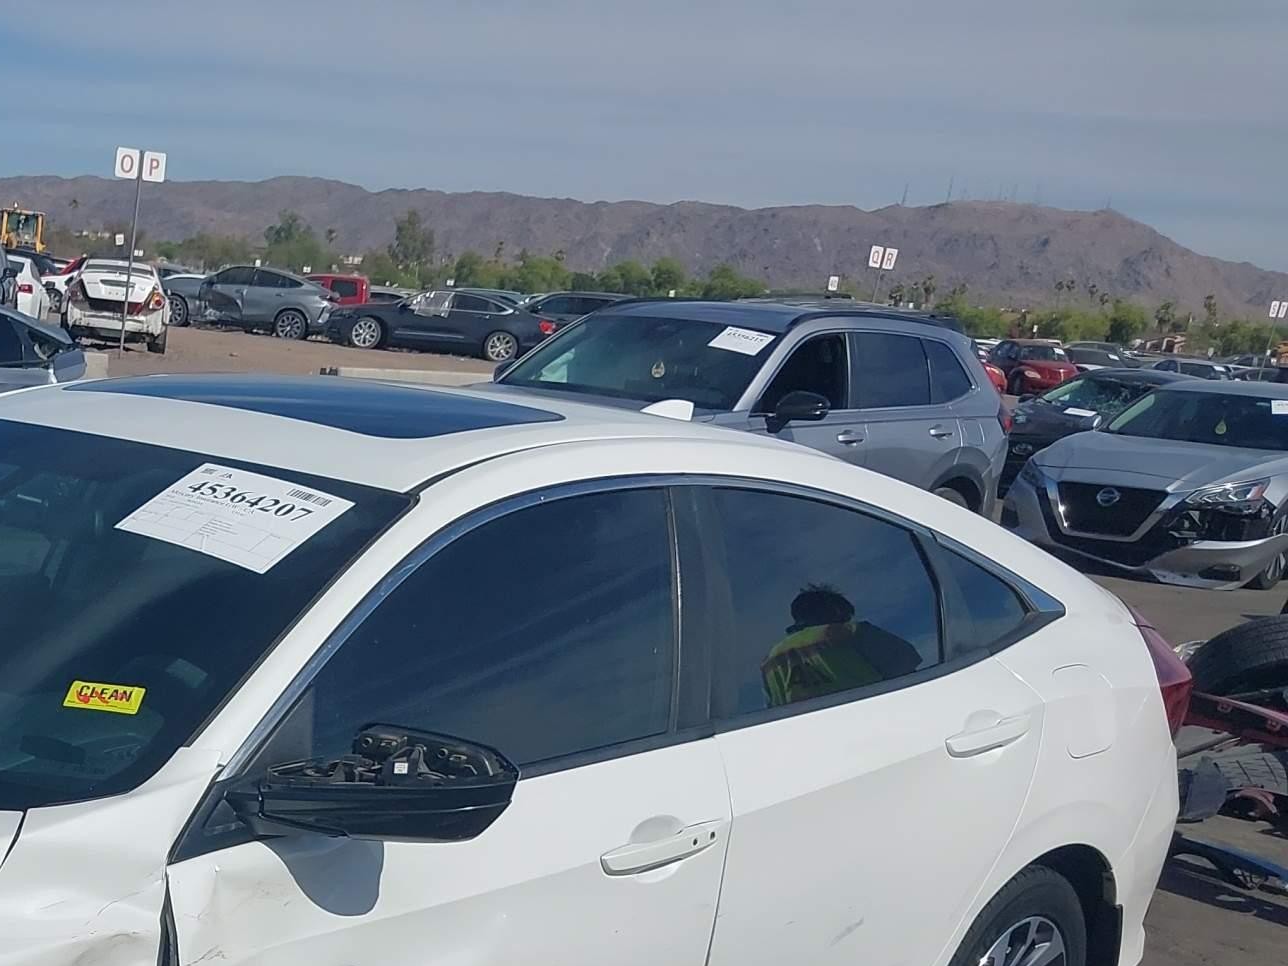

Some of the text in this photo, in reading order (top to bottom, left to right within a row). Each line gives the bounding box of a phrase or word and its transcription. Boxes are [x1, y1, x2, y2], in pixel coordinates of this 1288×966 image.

[120, 154, 160, 177] O P
[872, 250, 894, 267] Q R
[188, 480, 314, 521] 45364207
[79, 685, 134, 702] CLEAN
